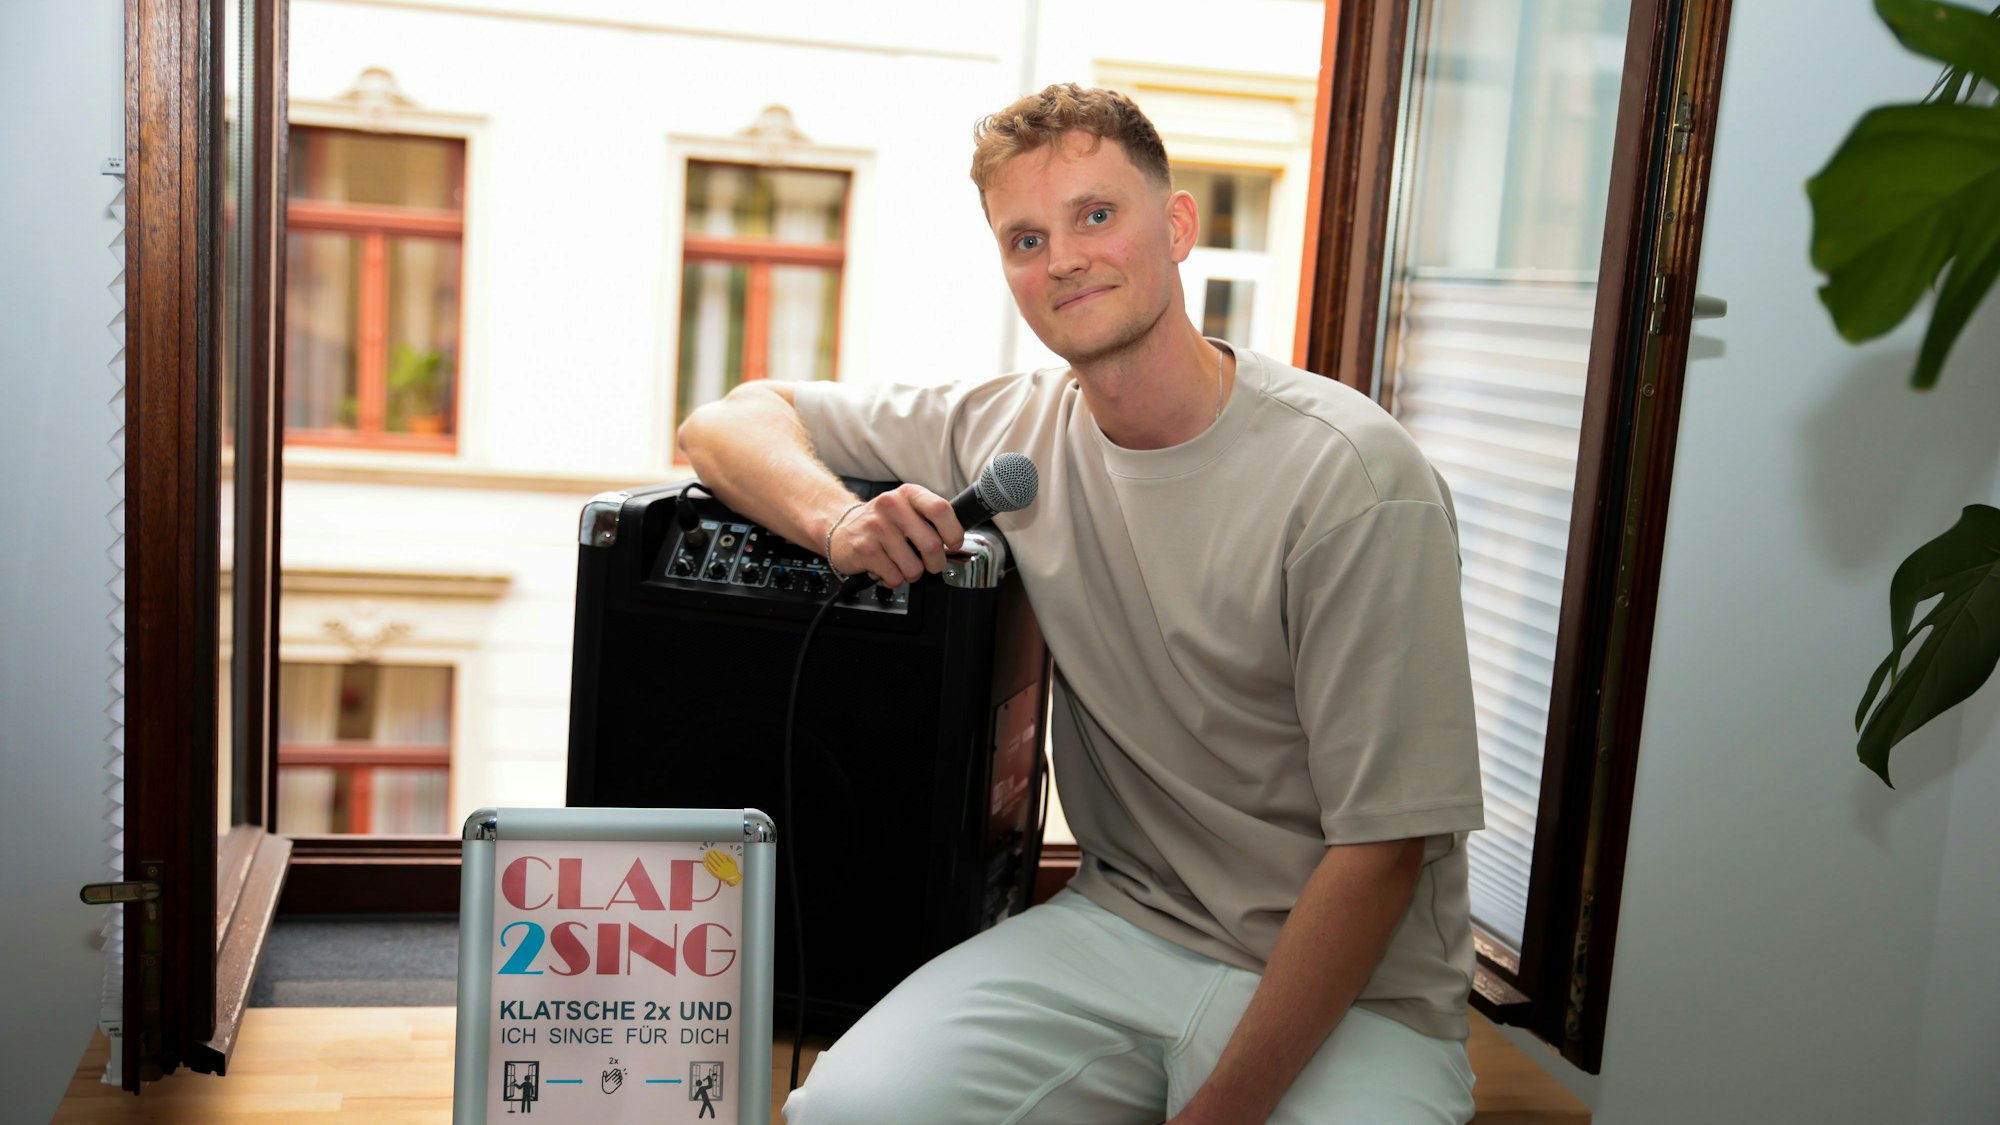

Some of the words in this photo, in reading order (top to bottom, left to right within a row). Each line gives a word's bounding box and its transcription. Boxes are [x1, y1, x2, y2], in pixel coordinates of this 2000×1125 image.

[501, 856, 721, 911] CLAP
[497, 921, 737, 977] 2SING
[500, 1001, 635, 1021] KLATSCHE
[643, 1001, 671, 1021] 2x
[680, 1001, 733, 1021] UND
[501, 1027, 536, 1044] ICH
[549, 1027, 613, 1044] SINGE
[626, 1025, 667, 1044] FÜR
[680, 1027, 729, 1044] DICH
[608, 1056, 619, 1065] 2x
